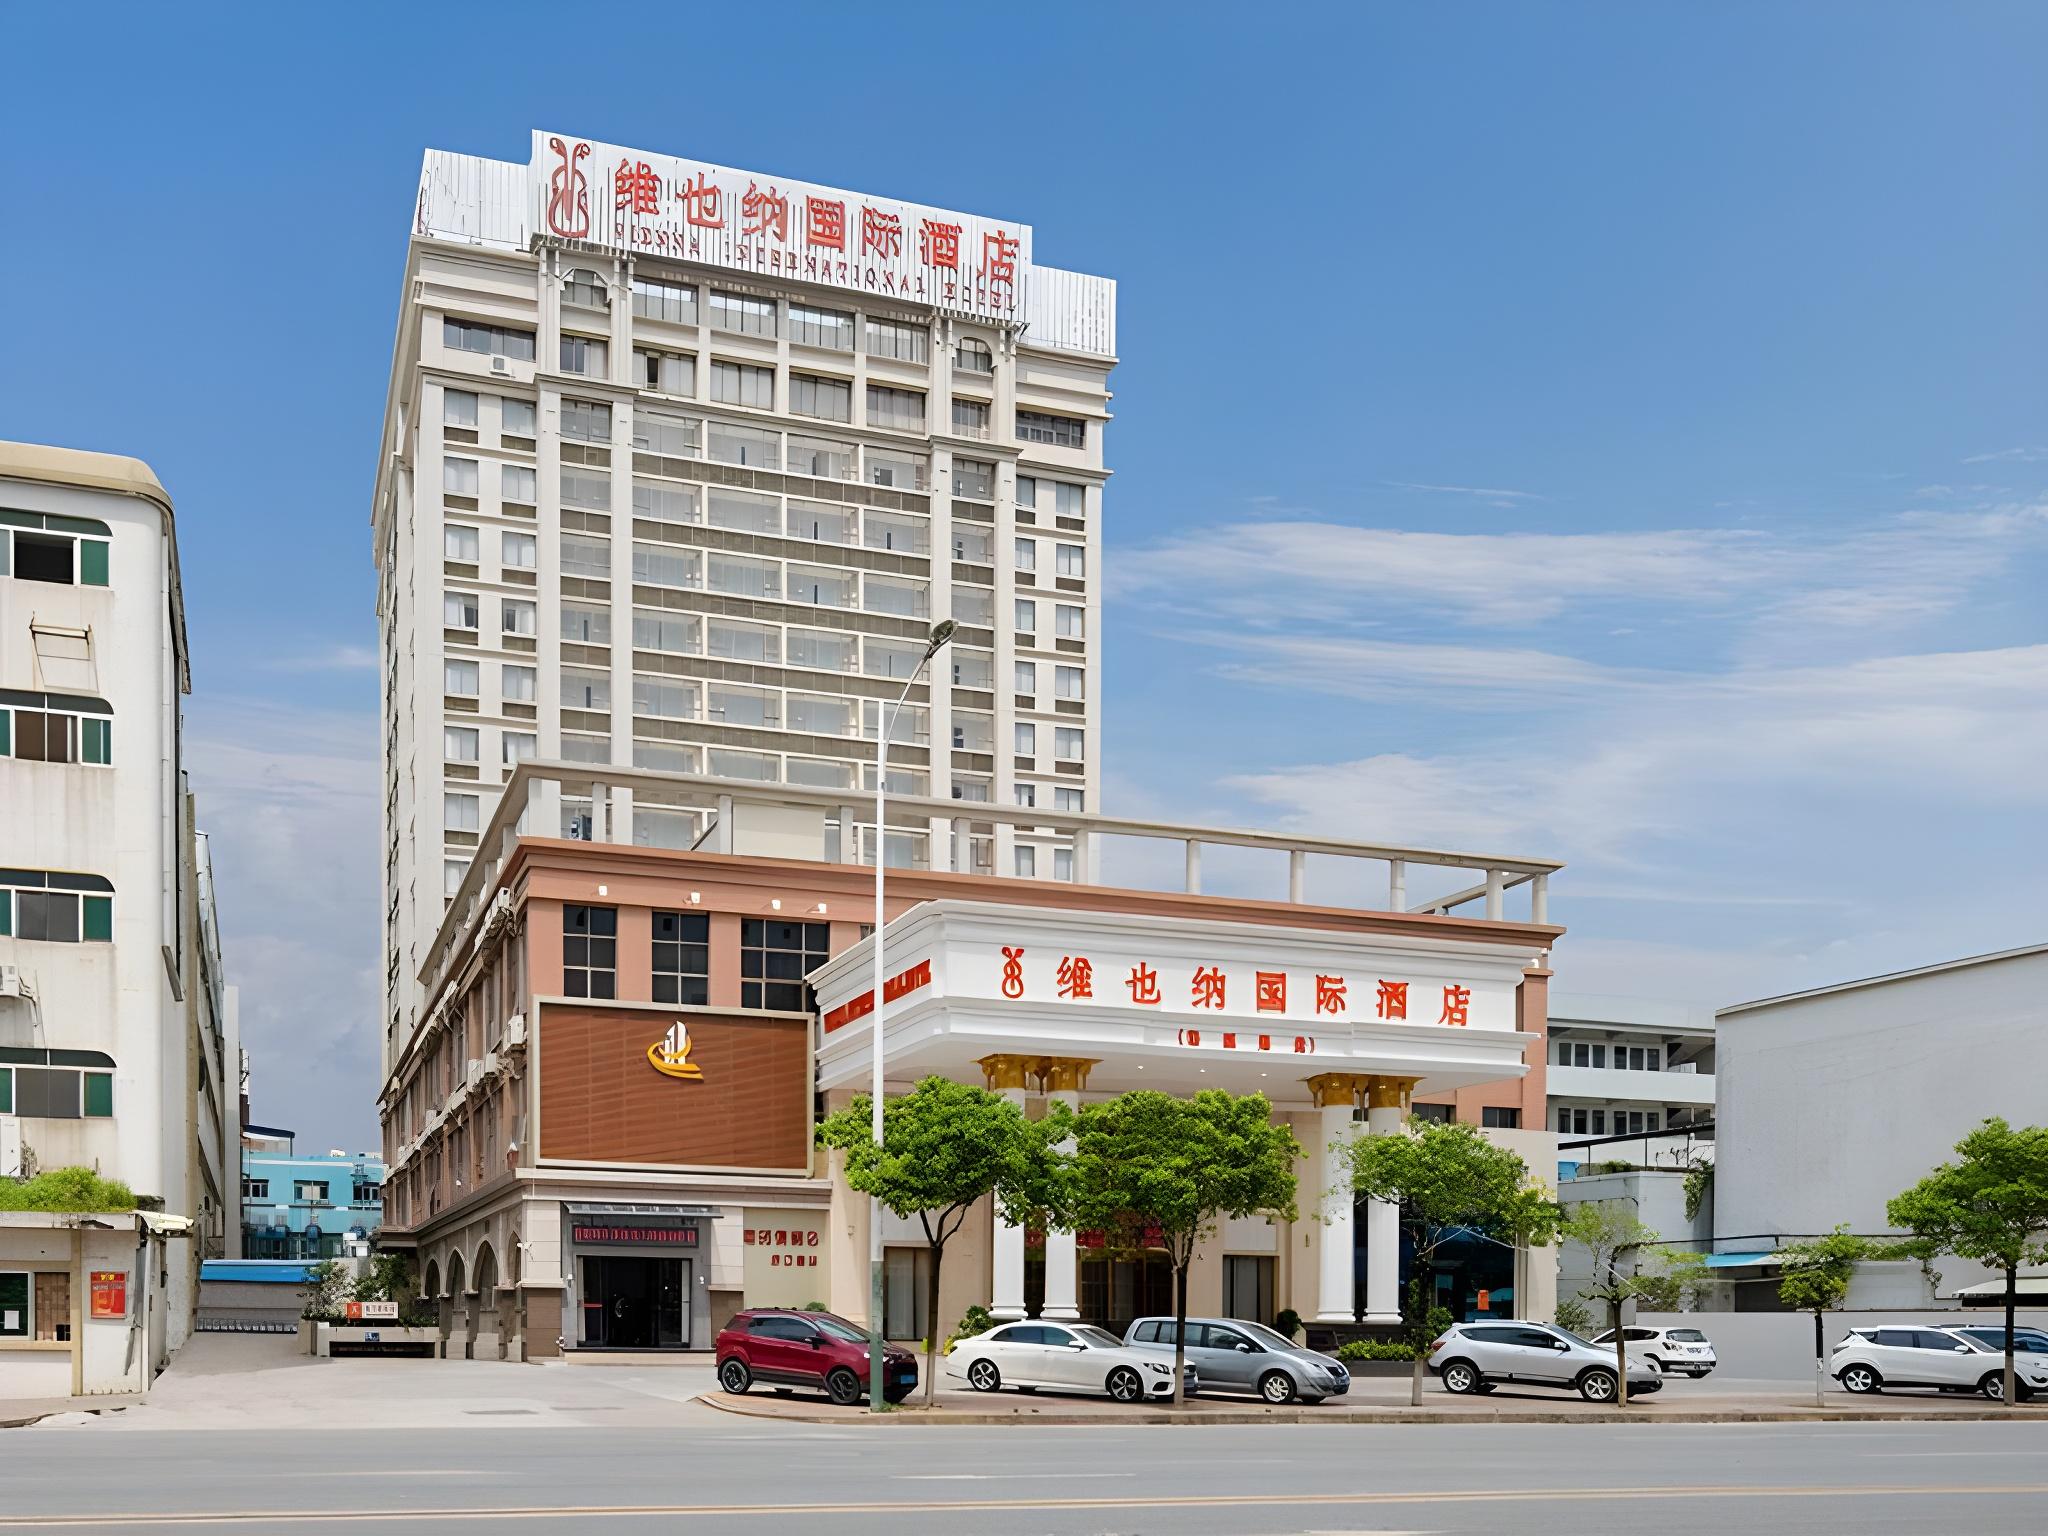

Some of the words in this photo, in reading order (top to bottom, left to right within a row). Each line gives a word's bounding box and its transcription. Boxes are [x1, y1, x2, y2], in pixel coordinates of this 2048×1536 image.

[615, 158, 1019, 286] 维也纳国际酒店
[1056, 957, 1470, 1027] 维也纳国际酒店
